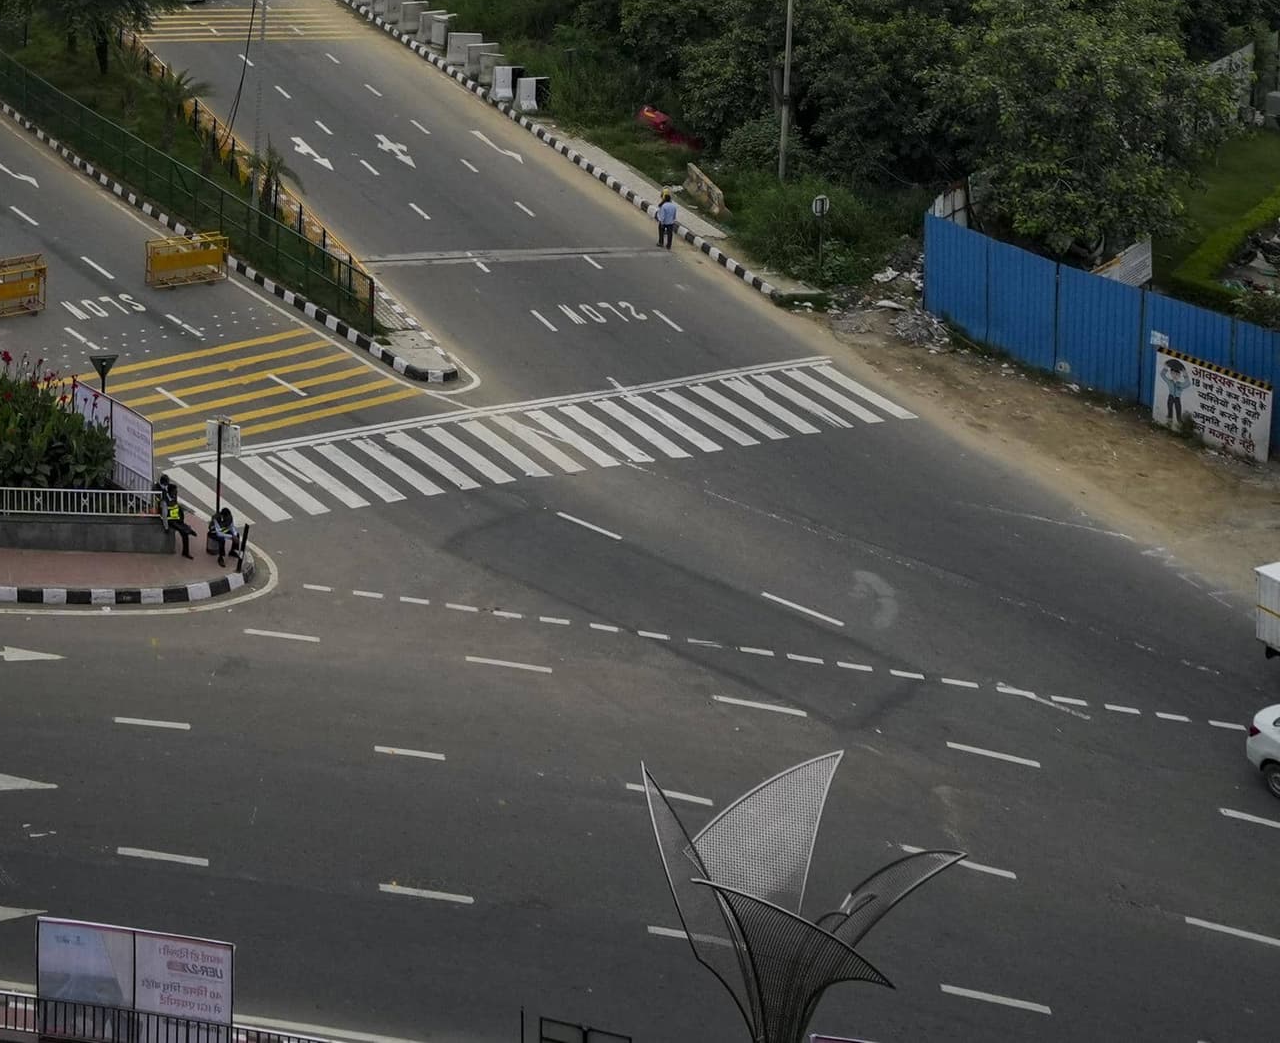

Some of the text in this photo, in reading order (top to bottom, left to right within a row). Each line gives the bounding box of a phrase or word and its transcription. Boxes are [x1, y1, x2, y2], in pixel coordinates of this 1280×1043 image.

[1192, 377, 1200, 387] 18
[1192, 367, 1269, 401] आवश्यक सूचना
